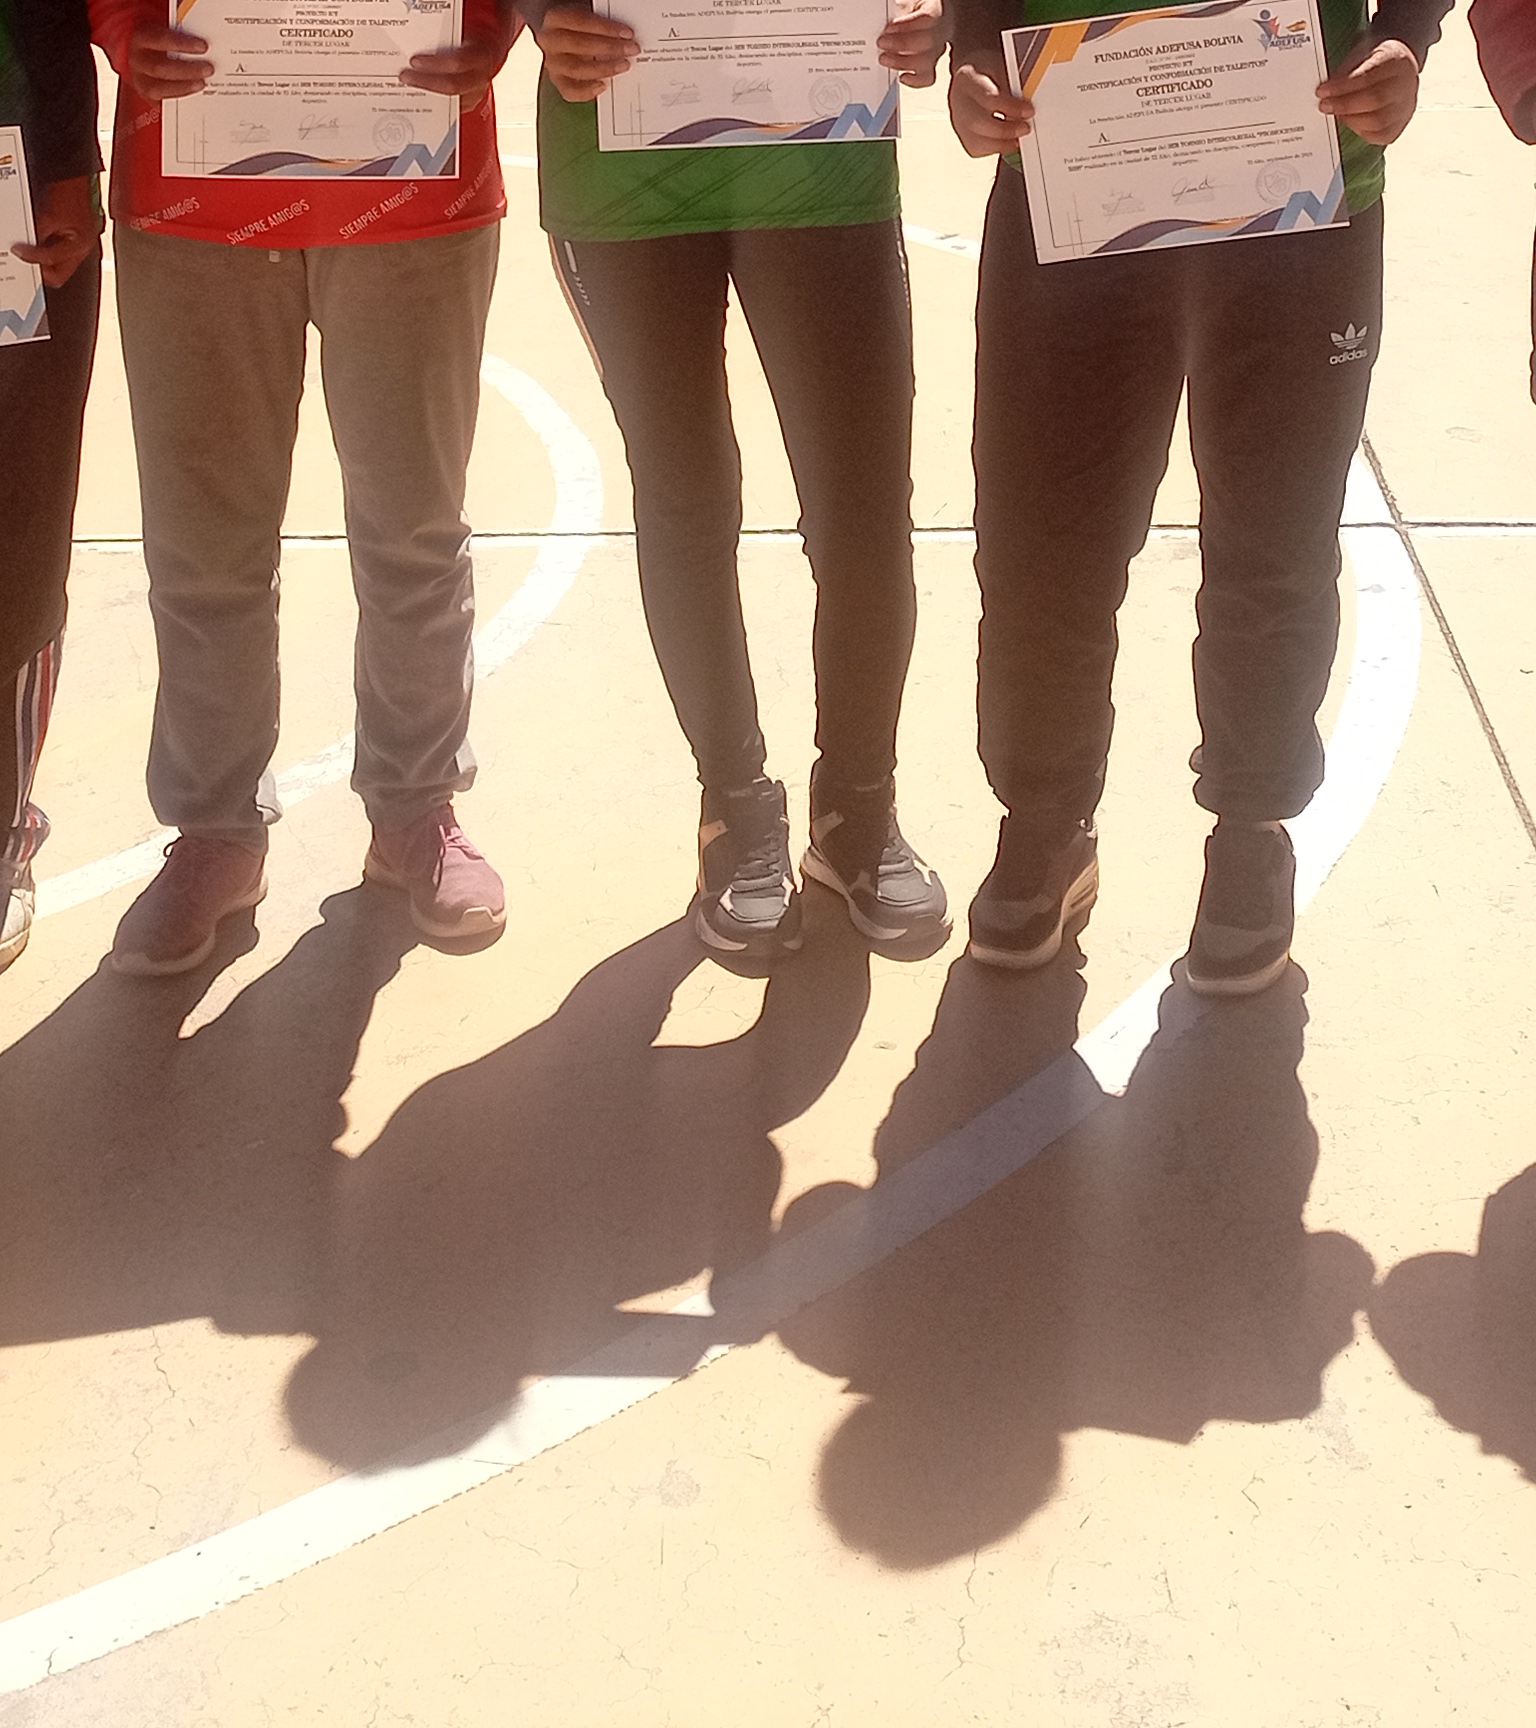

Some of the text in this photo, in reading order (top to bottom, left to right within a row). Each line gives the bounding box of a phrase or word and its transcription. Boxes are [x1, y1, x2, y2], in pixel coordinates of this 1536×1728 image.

[278, 28, 354, 38] CERTIFICADO
[1093, 44, 1154, 63] FUNDACIÓN
[1153, 39, 1202, 55] ADEFUSA
[1202, 34, 1244, 48] BOLIVIA
[1134, 77, 1214, 98] CERTIFICADO
[338, 181, 420, 240] SIEMPRE AMIG@S
[443, 184, 477, 221] SIEMPRE
[226, 198, 311, 246] SIEMPRE AMIG@S
[1329, 349, 1368, 366] adidas
